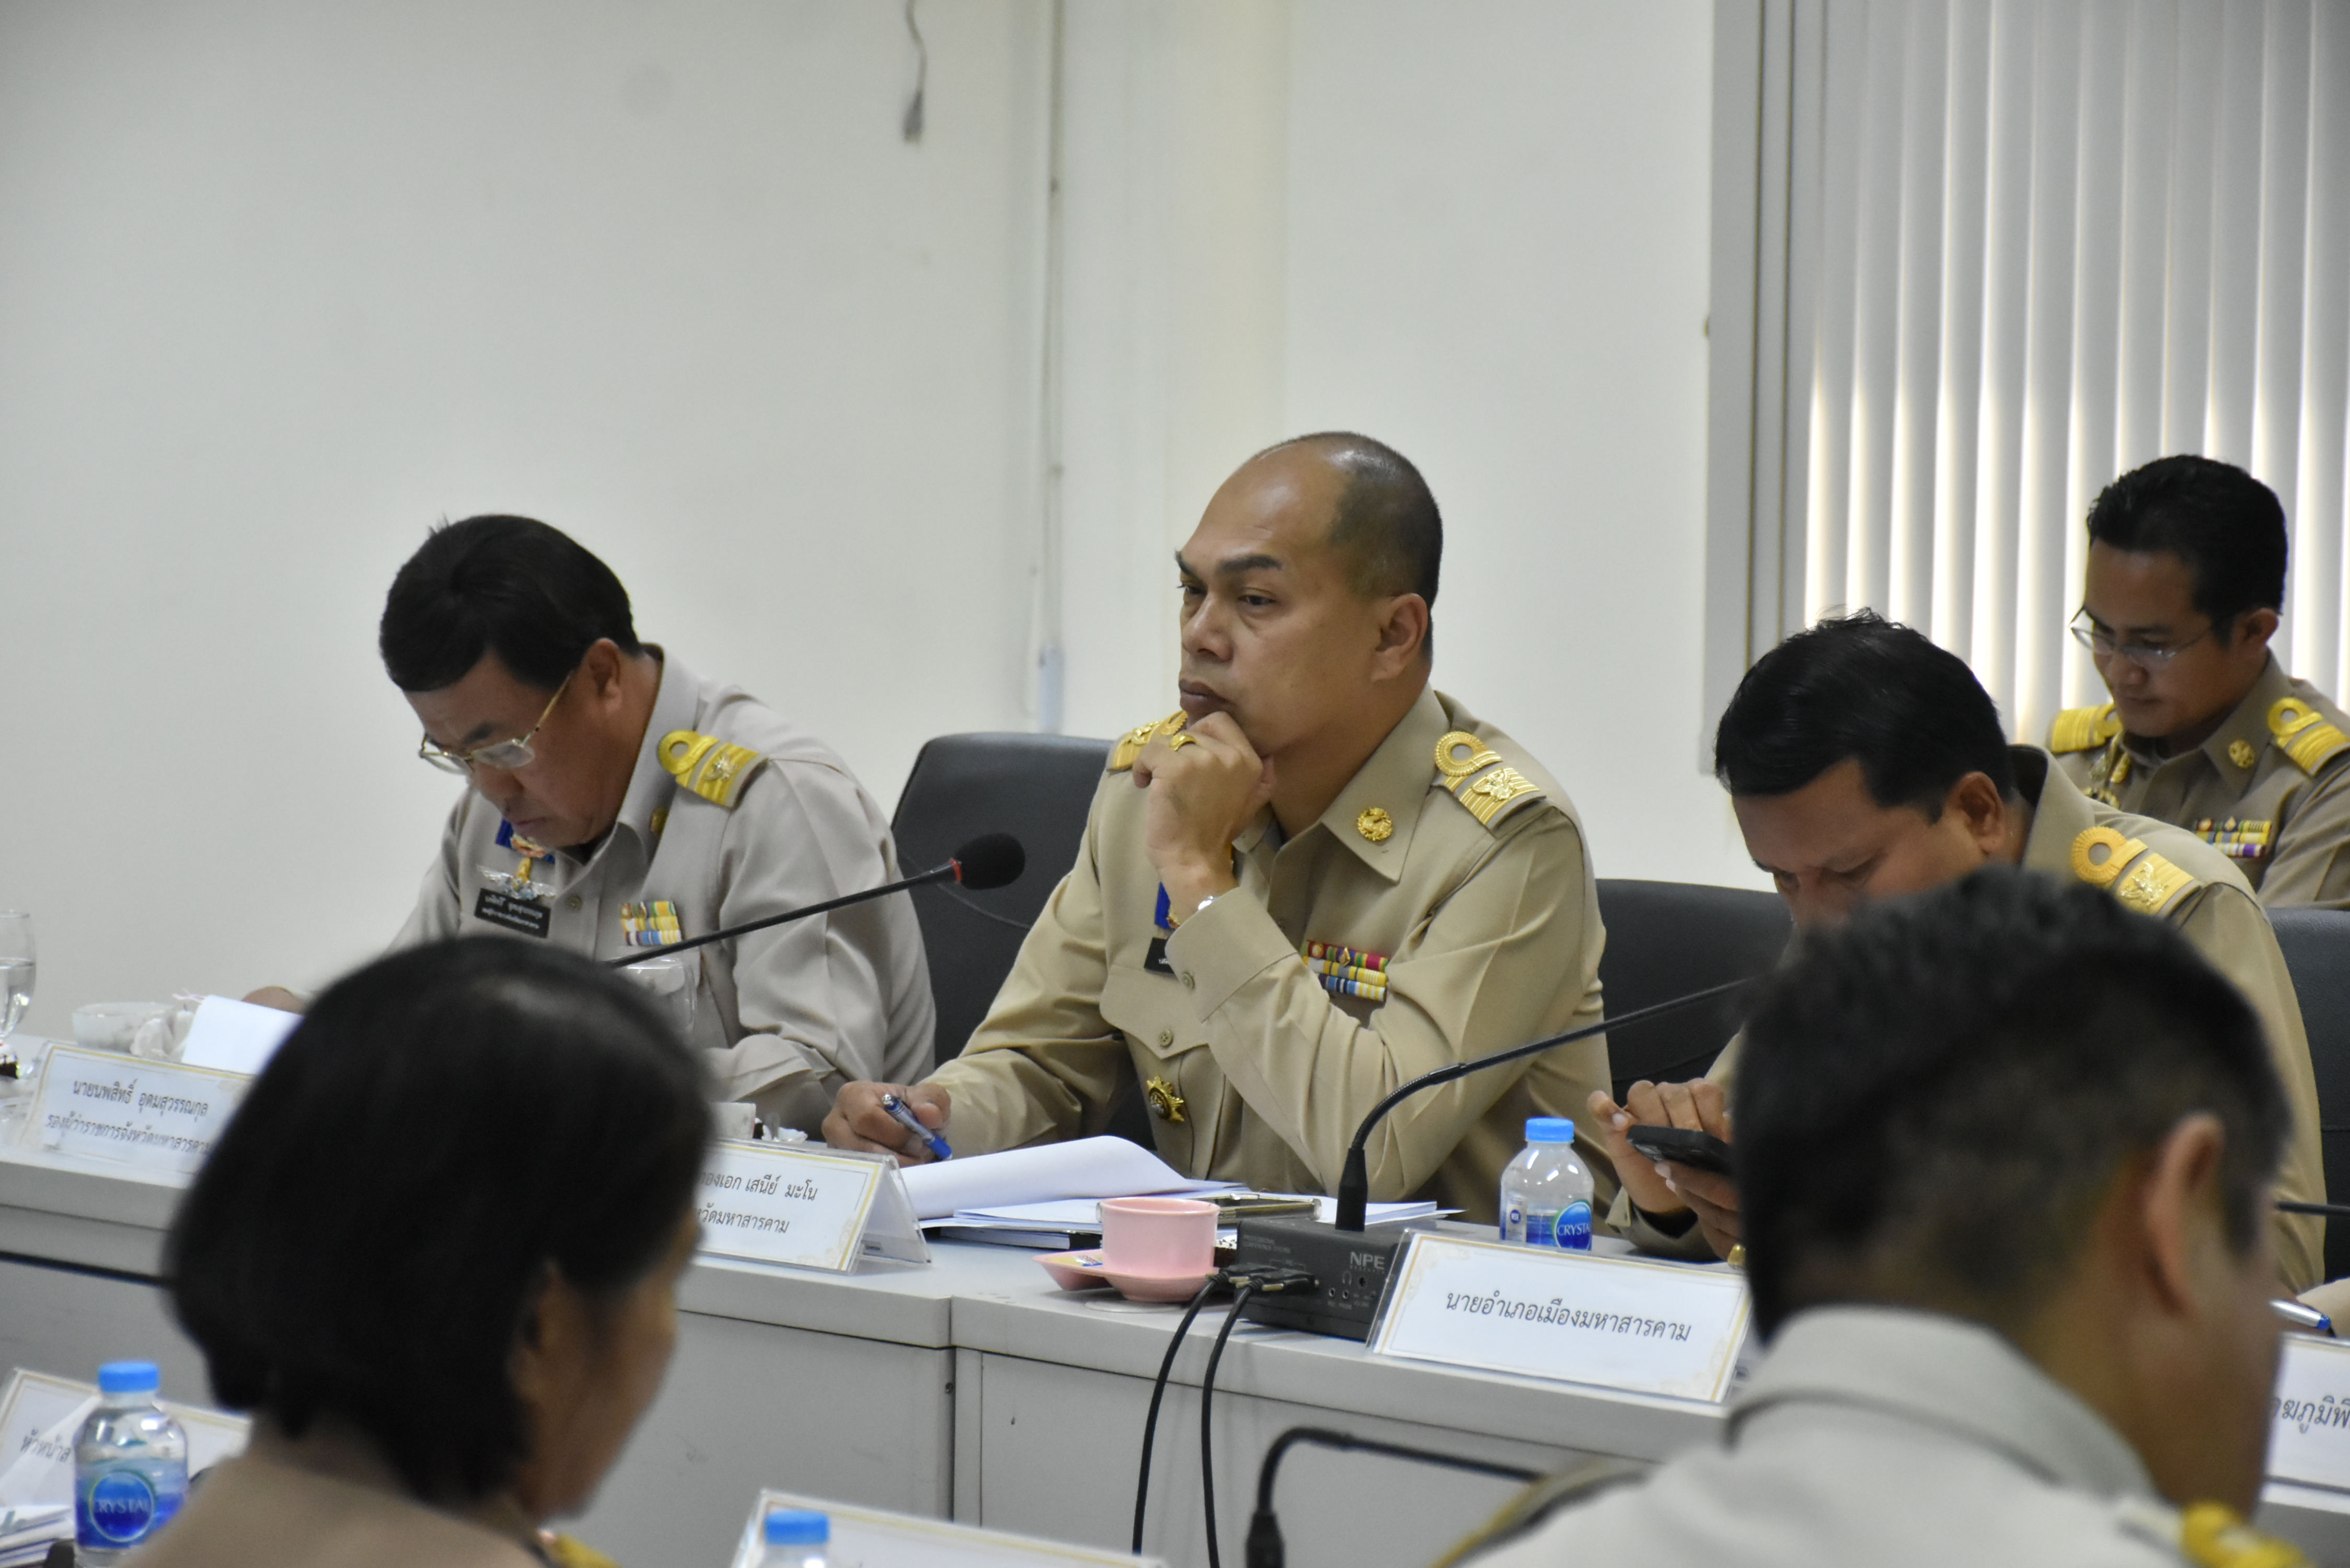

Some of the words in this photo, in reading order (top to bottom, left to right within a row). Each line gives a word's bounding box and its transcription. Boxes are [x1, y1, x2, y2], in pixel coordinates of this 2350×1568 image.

[745, 1174, 781, 1195] เสนีย์
[785, 1179, 818, 1201] มะโน
[1350, 1252, 1385, 1270] NPE
[1446, 1289, 1691, 1343] นายอำเภอเมืองมหาสารคาม
